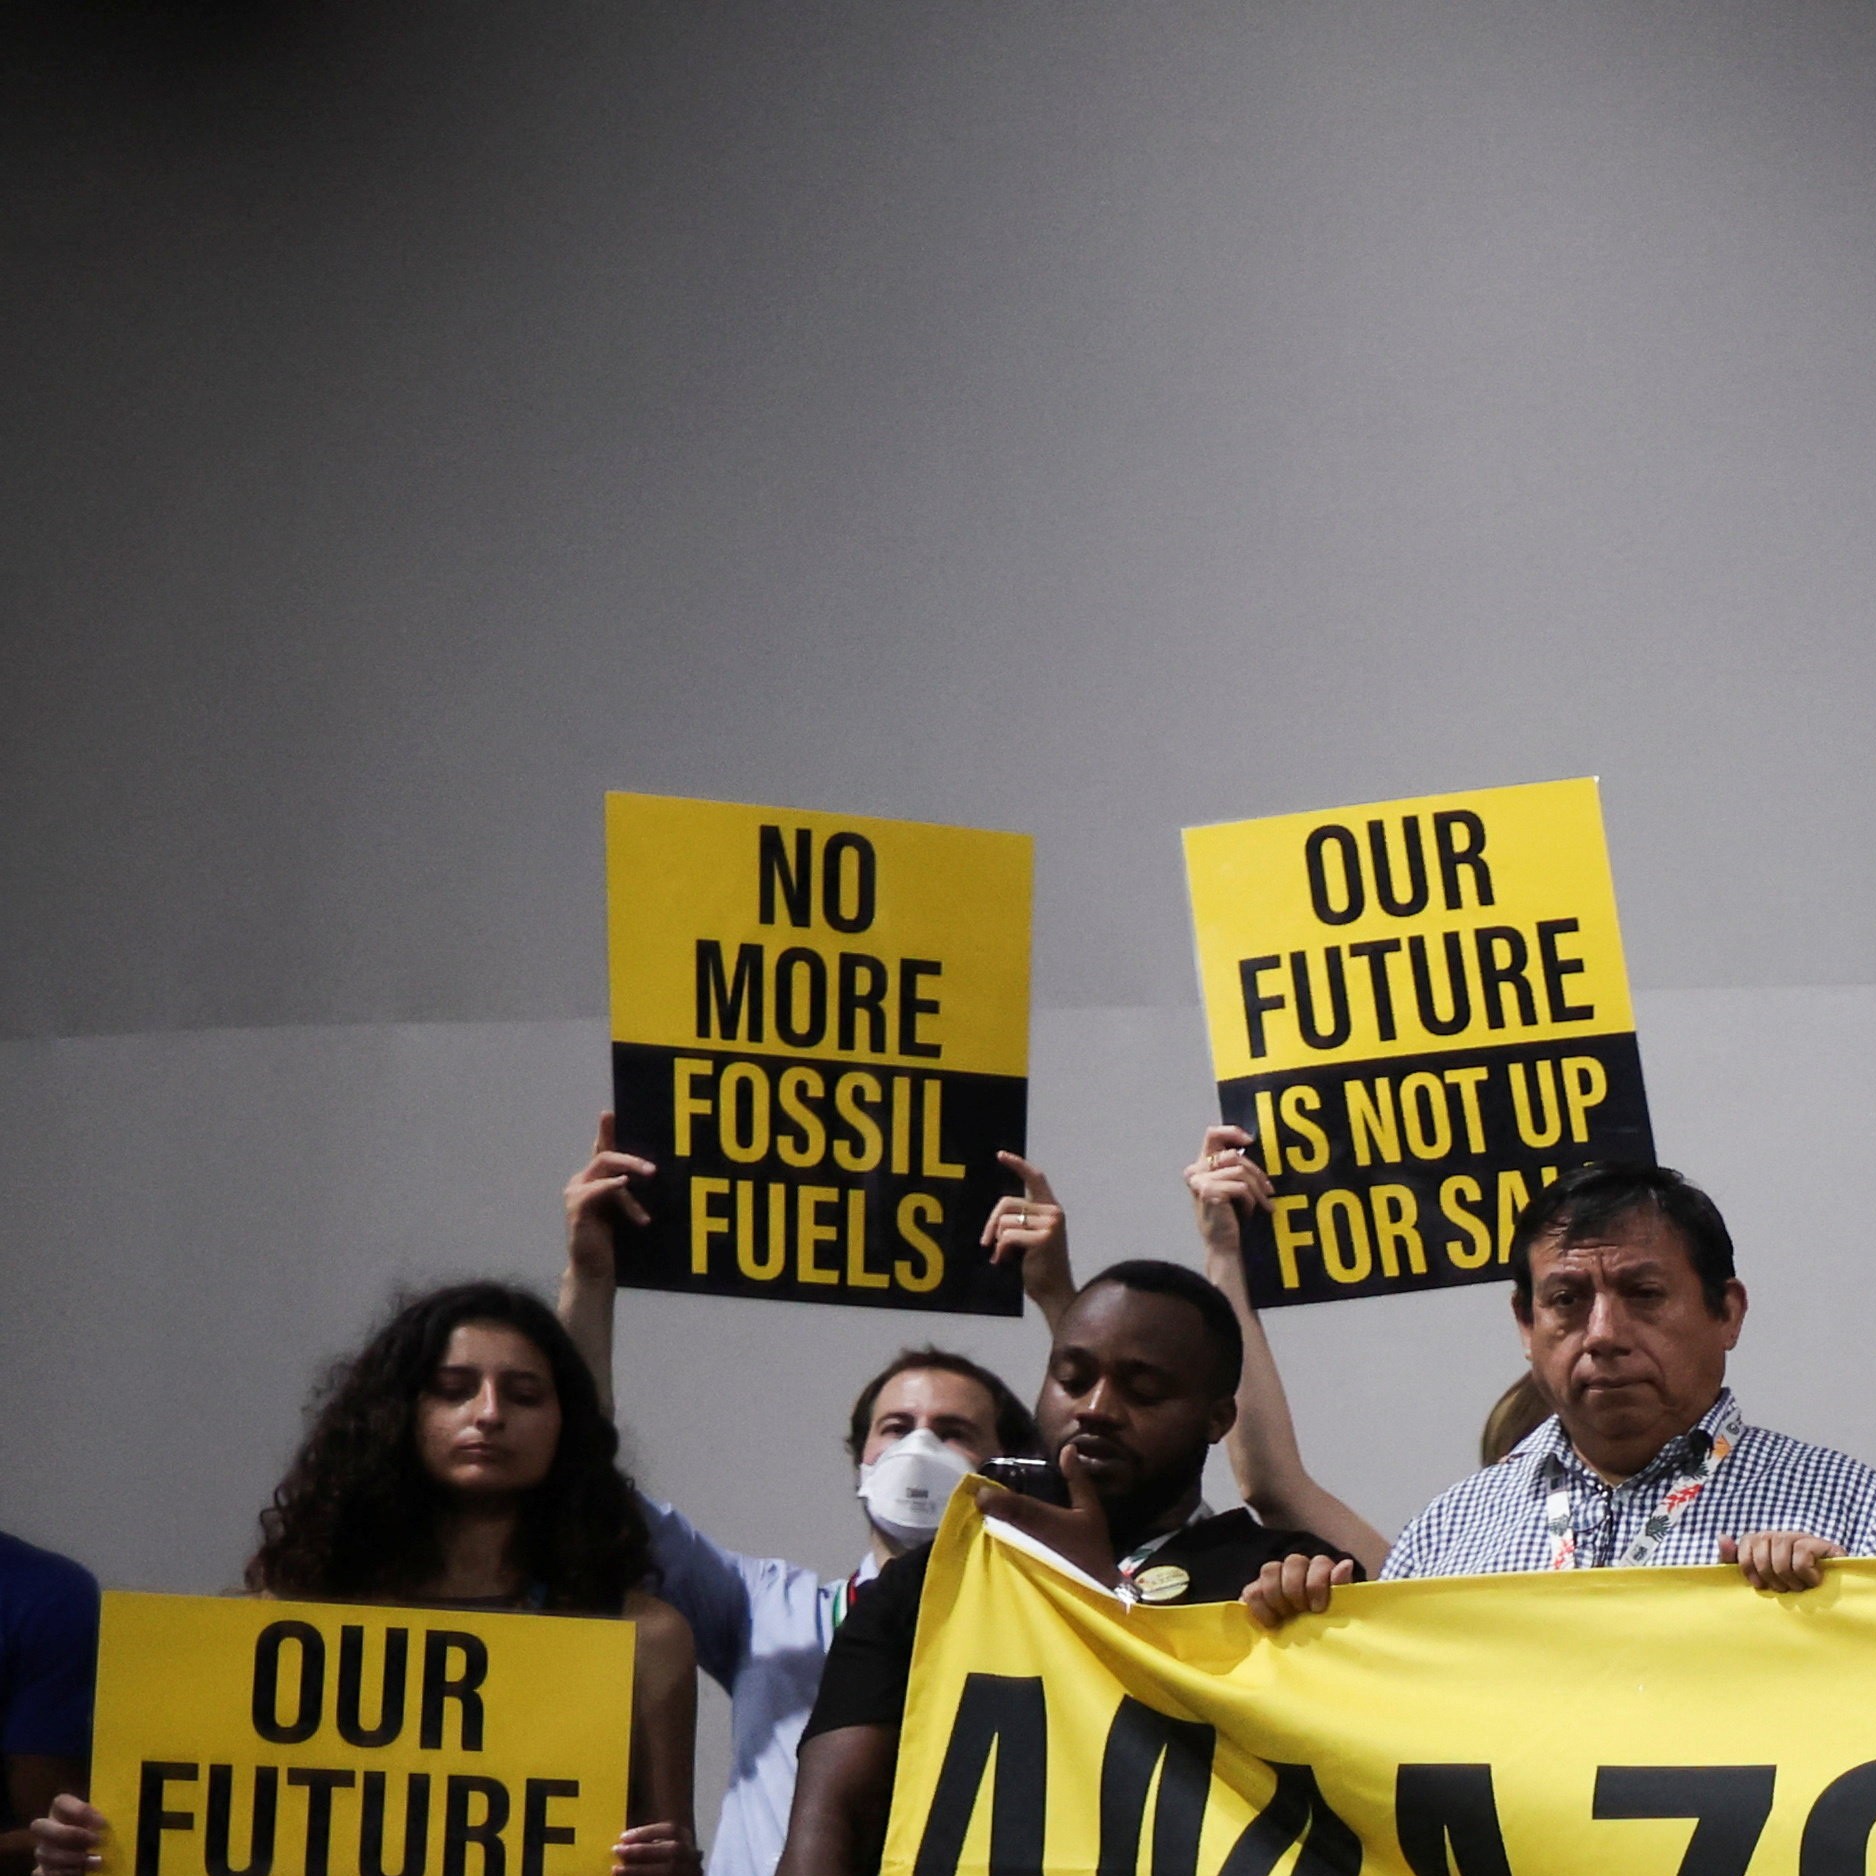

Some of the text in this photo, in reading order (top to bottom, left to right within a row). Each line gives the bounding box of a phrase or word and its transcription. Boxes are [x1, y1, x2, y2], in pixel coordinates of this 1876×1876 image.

[758, 825, 876, 934] NO
[1304, 809, 1495, 927] OUR
[695, 939, 942, 1058] MORE
[1238, 917, 1594, 1059] FUTURE
[673, 1057, 966, 1179] FOSSIL
[1254, 1056, 1608, 1177] IS NOT UP
[691, 1176, 944, 1294] FUELS
[1270, 1182, 1428, 1289] FOR
[251, 1619, 488, 1752] OUR
